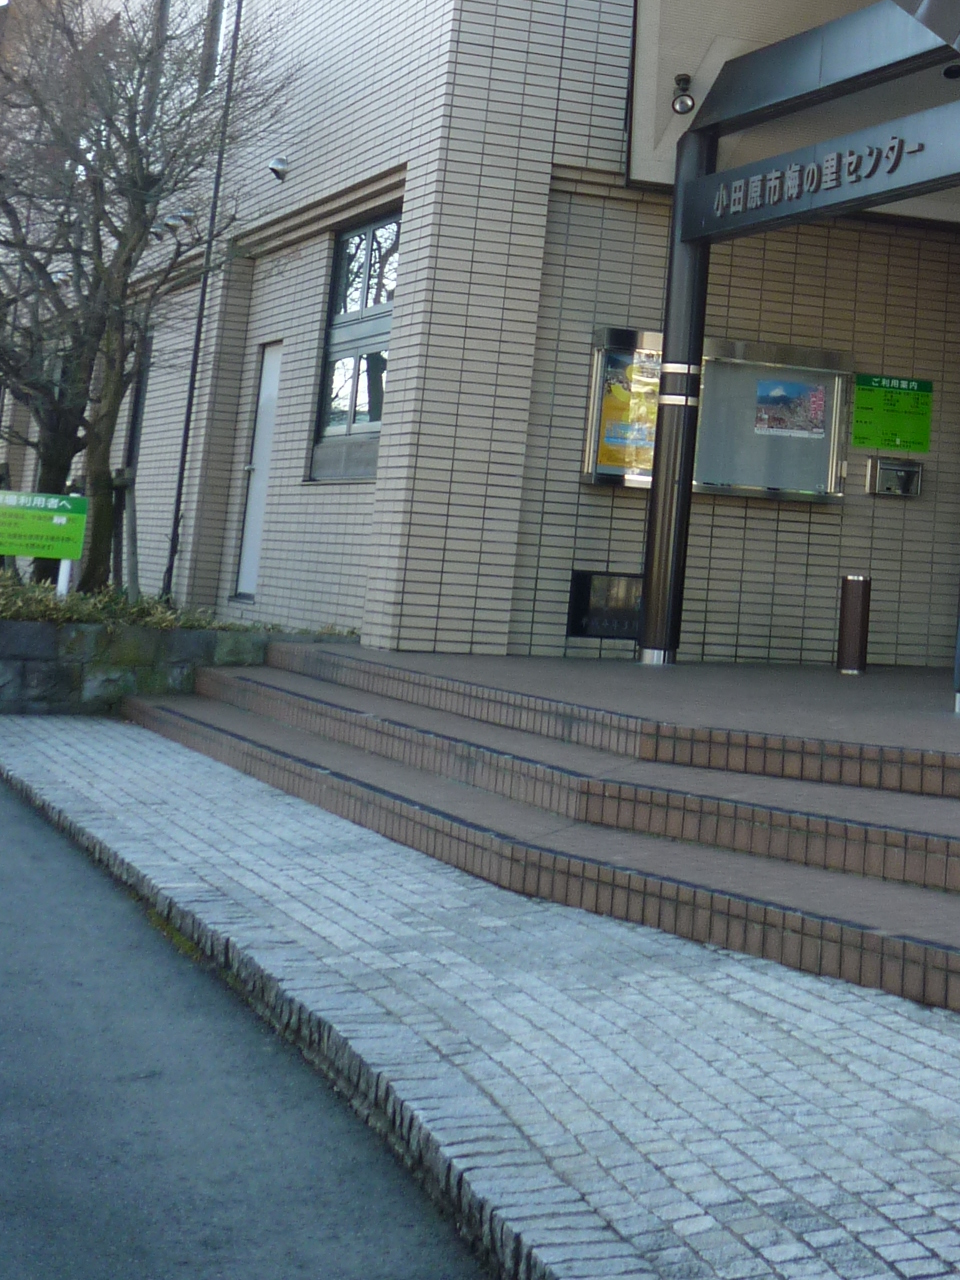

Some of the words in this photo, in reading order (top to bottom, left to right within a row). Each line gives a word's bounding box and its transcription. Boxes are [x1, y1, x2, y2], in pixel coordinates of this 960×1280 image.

[714, 136, 924, 217] 小田原市梅の里センター
[872, 377, 918, 391] ご利用案内
[0, 494, 72, 509] 場利用者へ
